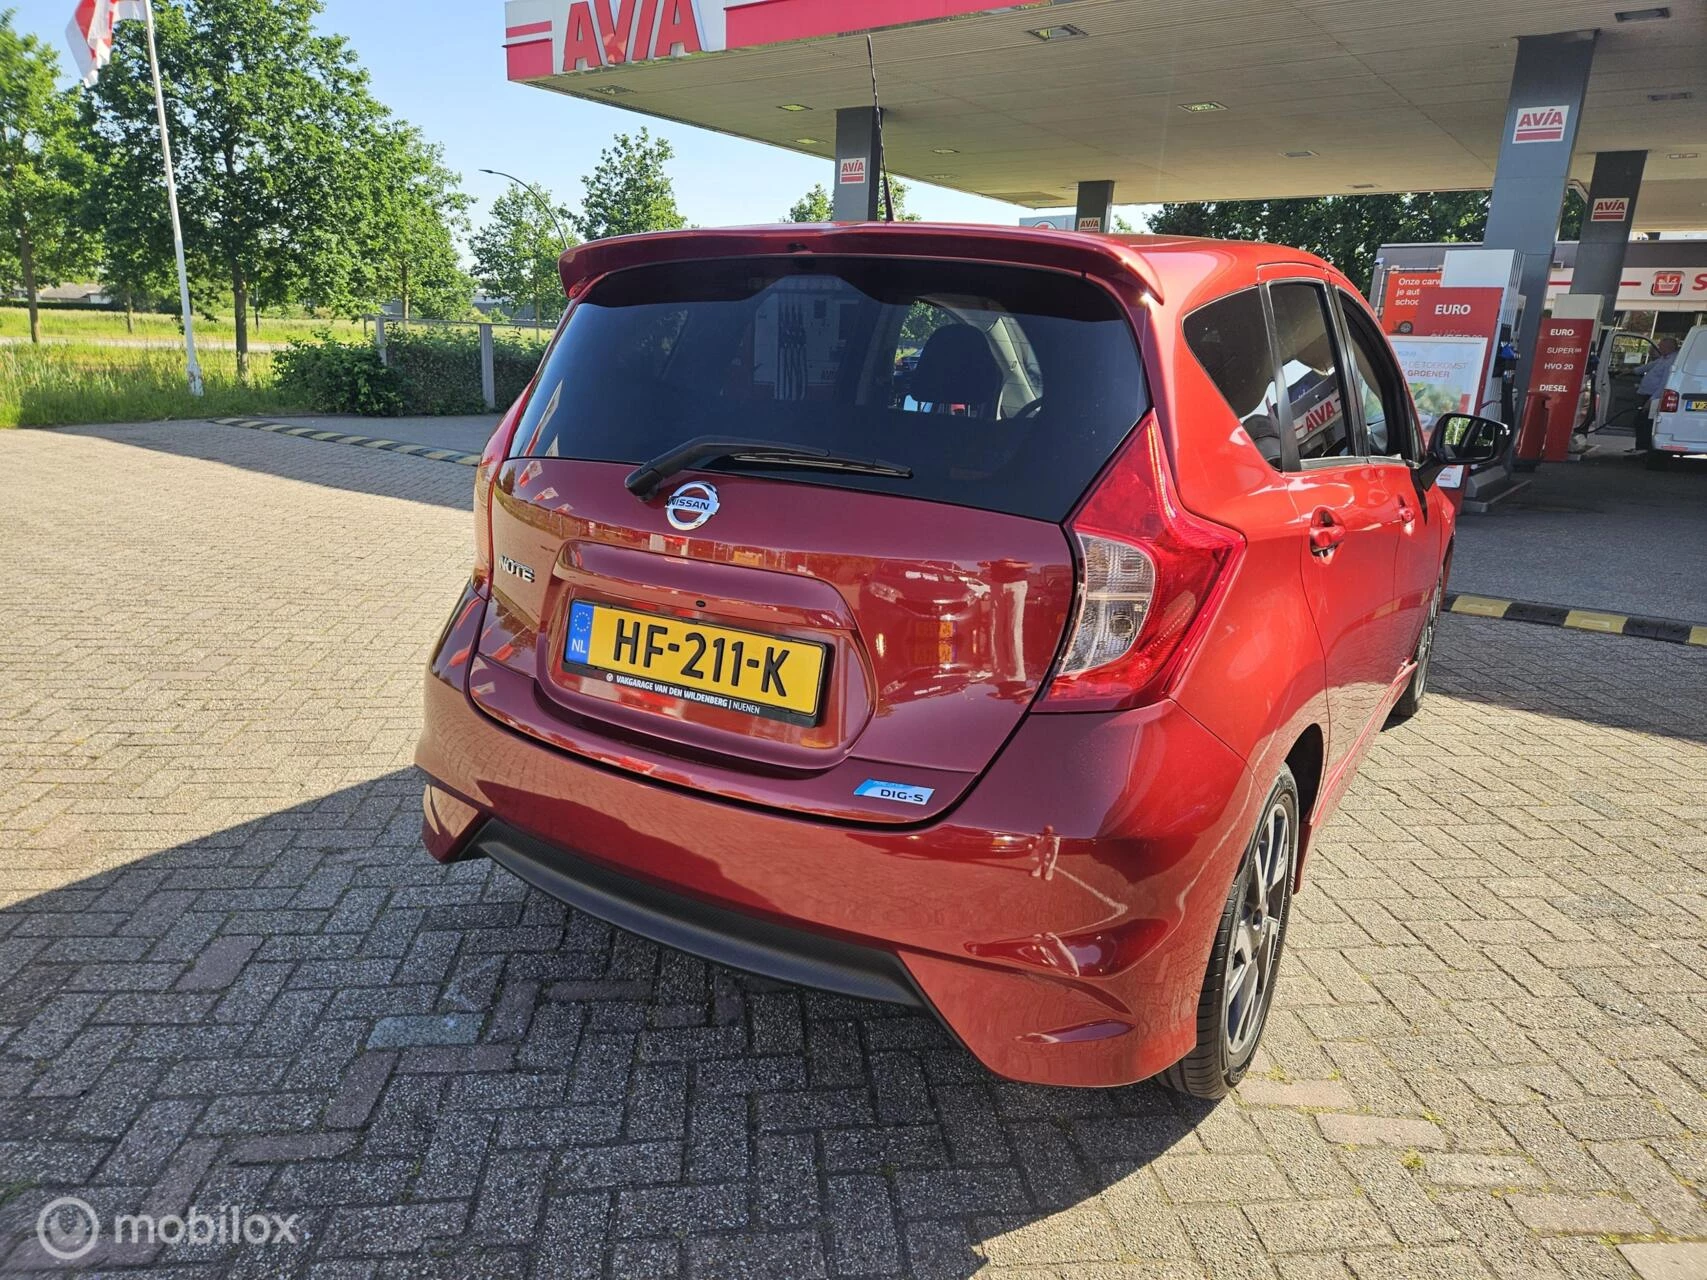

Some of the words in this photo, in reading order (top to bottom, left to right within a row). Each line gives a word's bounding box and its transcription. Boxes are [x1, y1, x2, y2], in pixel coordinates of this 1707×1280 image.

[563, 0, 702, 71] AVIA
[1396, 287, 1405, 296] je
[1434, 304, 1471, 315] EURO
[1550, 328, 1575, 336] EURO
[1547, 346, 1574, 354] SUPER
[1539, 384, 1568, 392] DIESEL
[669, 498, 710, 510] NISSAN
[499, 555, 535, 583] NOTE
[571, 638, 587, 654] NL
[613, 619, 790, 697] HF-211-K
[616, 675, 654, 691] VAKGARAGE
[654, 683, 669, 694] VAN
[669, 687, 682, 697] DEN
[684, 690, 728, 708] WILDENBERG
[732, 702, 761, 715] NUENEN
[880, 789, 924, 802] DIG-S
